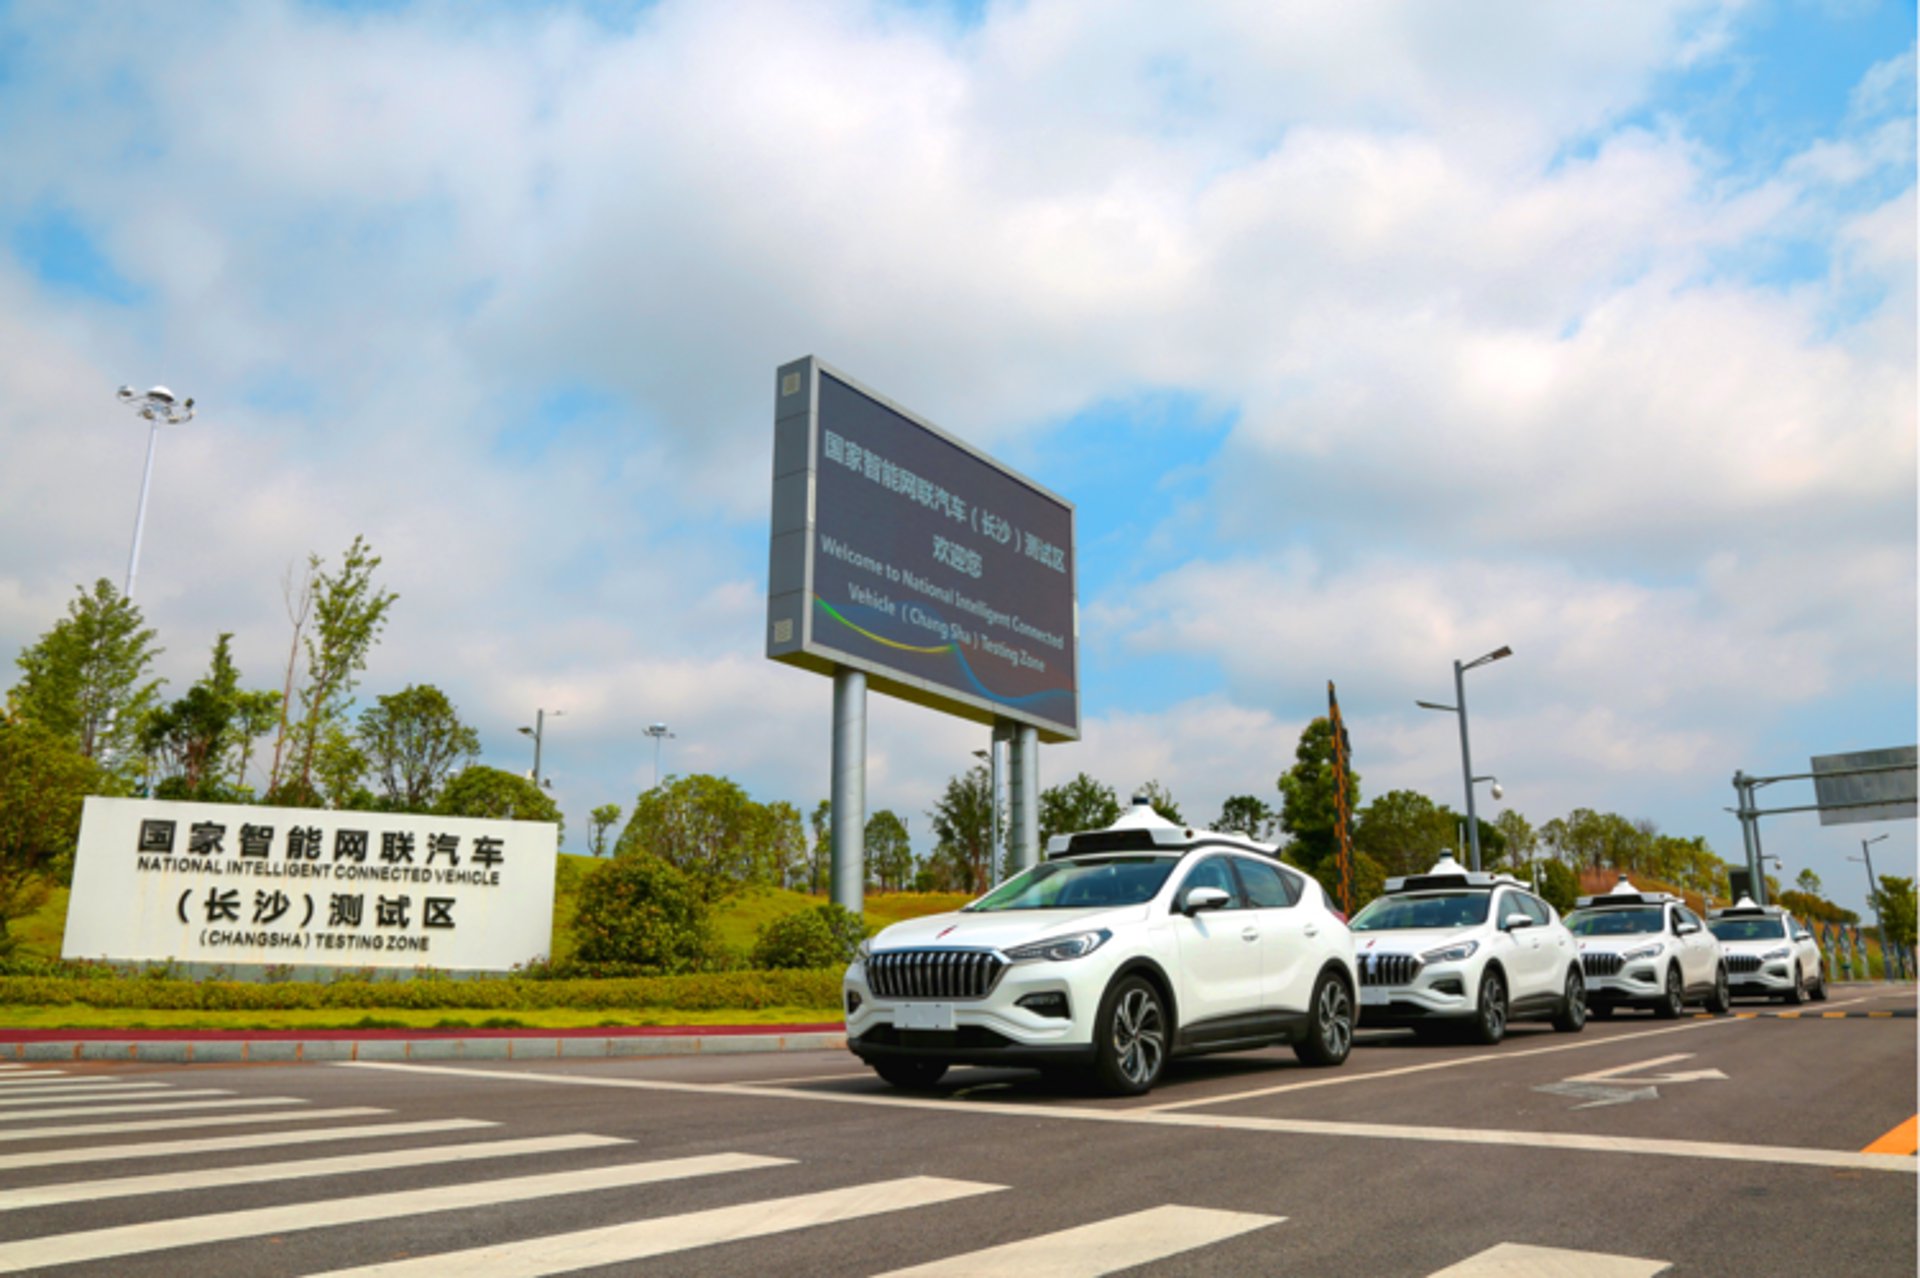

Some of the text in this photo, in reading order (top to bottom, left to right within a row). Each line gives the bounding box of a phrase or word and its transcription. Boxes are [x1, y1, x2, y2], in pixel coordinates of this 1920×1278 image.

[933, 534, 982, 578] 欢迎您
[821, 533, 1064, 650] Welcome to National Intelligent Connected
[848, 581, 895, 616] Vehicle
[981, 633, 1018, 668] Testing
[1019, 649, 1045, 672] Zone
[137, 818, 504, 869] 国家智能网联汽车
[137, 856, 500, 886] NATIONAL INTELLIGENT CONNECTED VEHICLE
[200, 930, 430, 951] (CHANGSHA) TESTING ZONE
